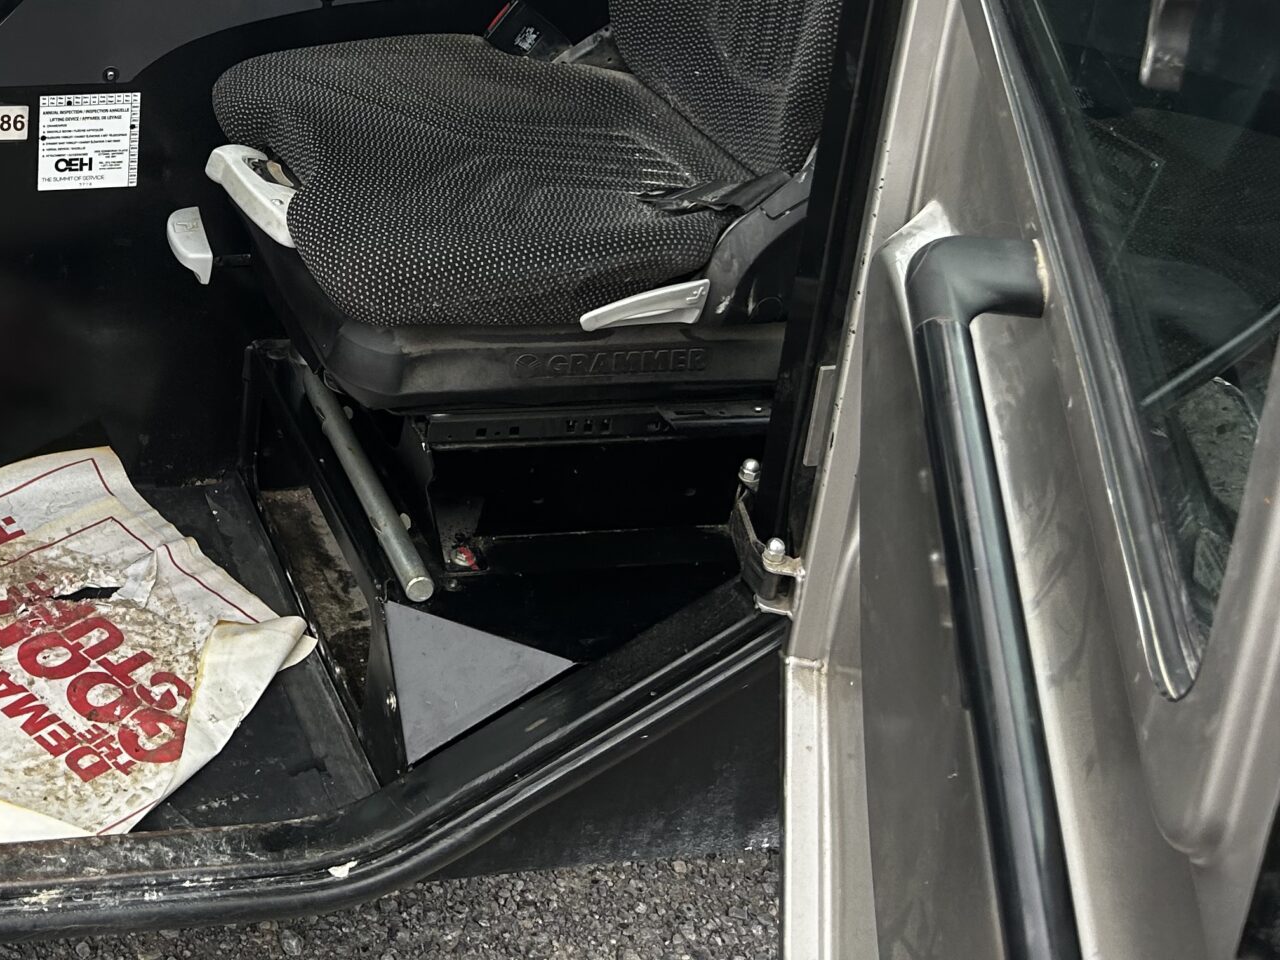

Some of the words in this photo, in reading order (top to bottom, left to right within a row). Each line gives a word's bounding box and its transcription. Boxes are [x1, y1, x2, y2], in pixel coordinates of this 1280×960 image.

[54, 157, 93, 172] OEH
[547, 348, 707, 373] GRAMMER
[75, 723, 137, 777] THE
